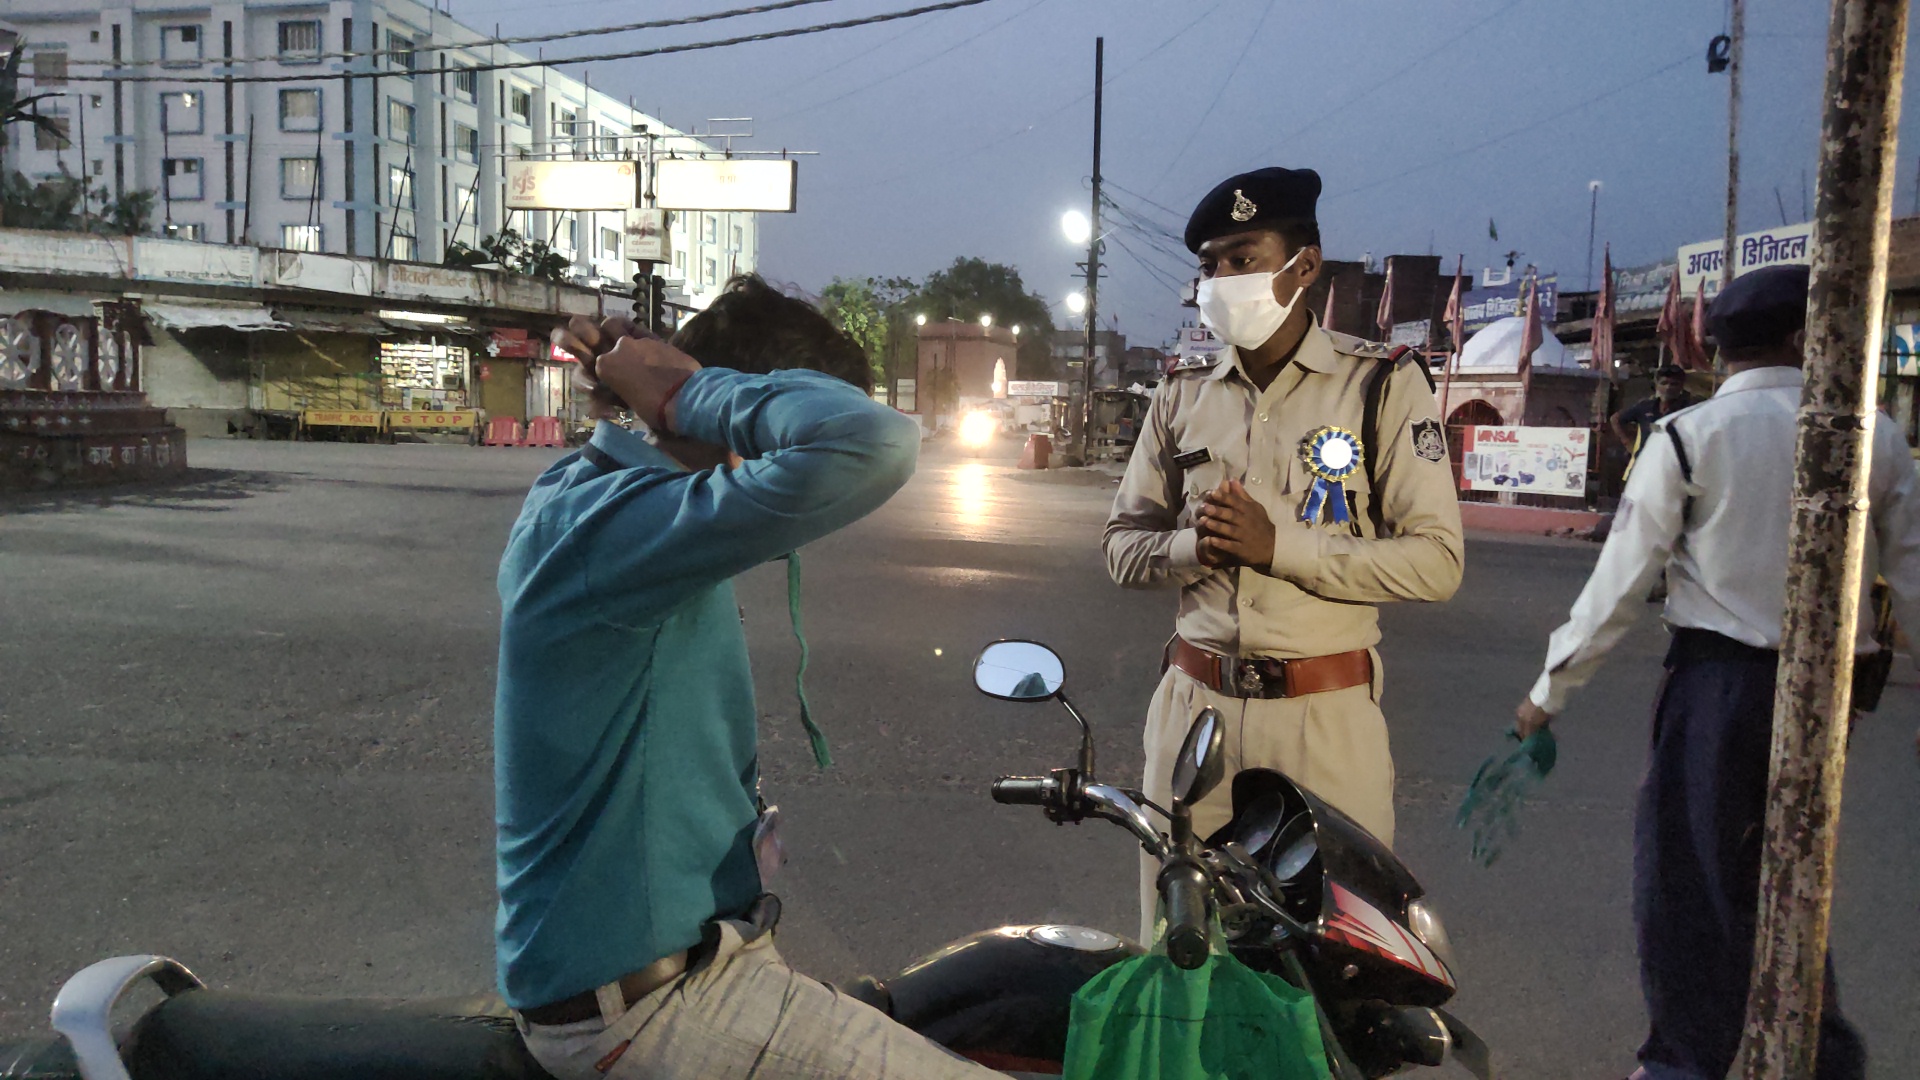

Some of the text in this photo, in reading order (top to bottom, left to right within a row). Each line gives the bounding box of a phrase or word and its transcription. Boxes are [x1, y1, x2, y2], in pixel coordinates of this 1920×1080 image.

[512, 172, 536, 194] KJS
[1742, 235, 1808, 267] डिजिटल
[314, 414, 373, 423] TRAFFIC POLICE
[402, 415, 462, 424] STOP
